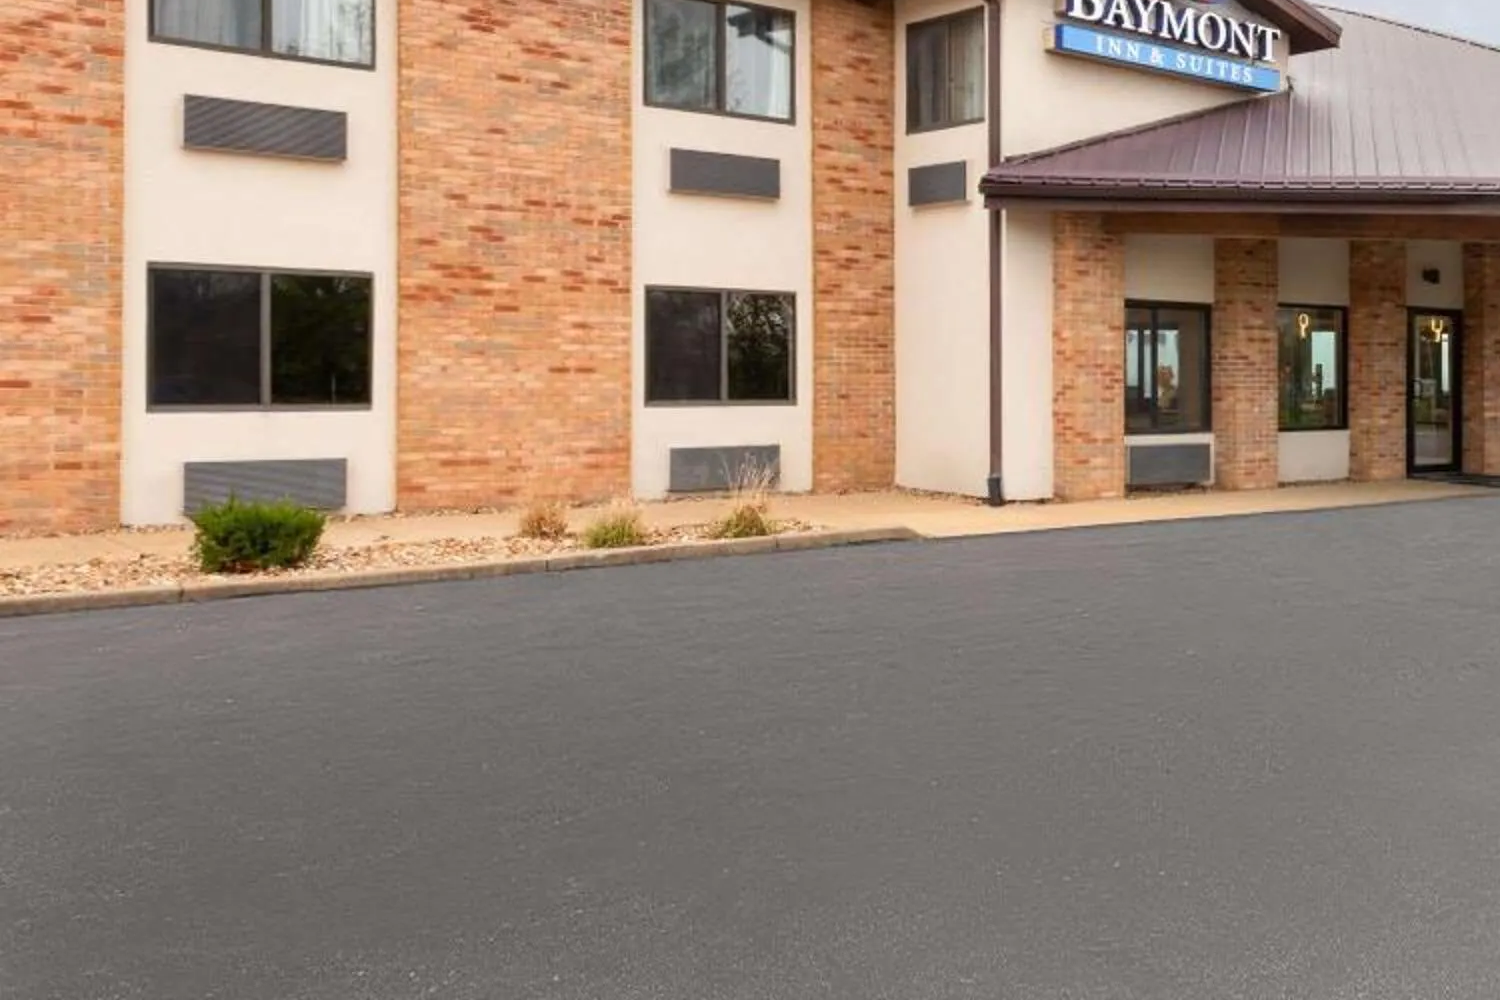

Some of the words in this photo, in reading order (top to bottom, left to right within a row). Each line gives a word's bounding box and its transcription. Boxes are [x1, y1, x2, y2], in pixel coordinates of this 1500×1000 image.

[1096, 35, 1140, 61] INN
[1150, 49, 1164, 67] &
[1177, 54, 1253, 83] SUITES
